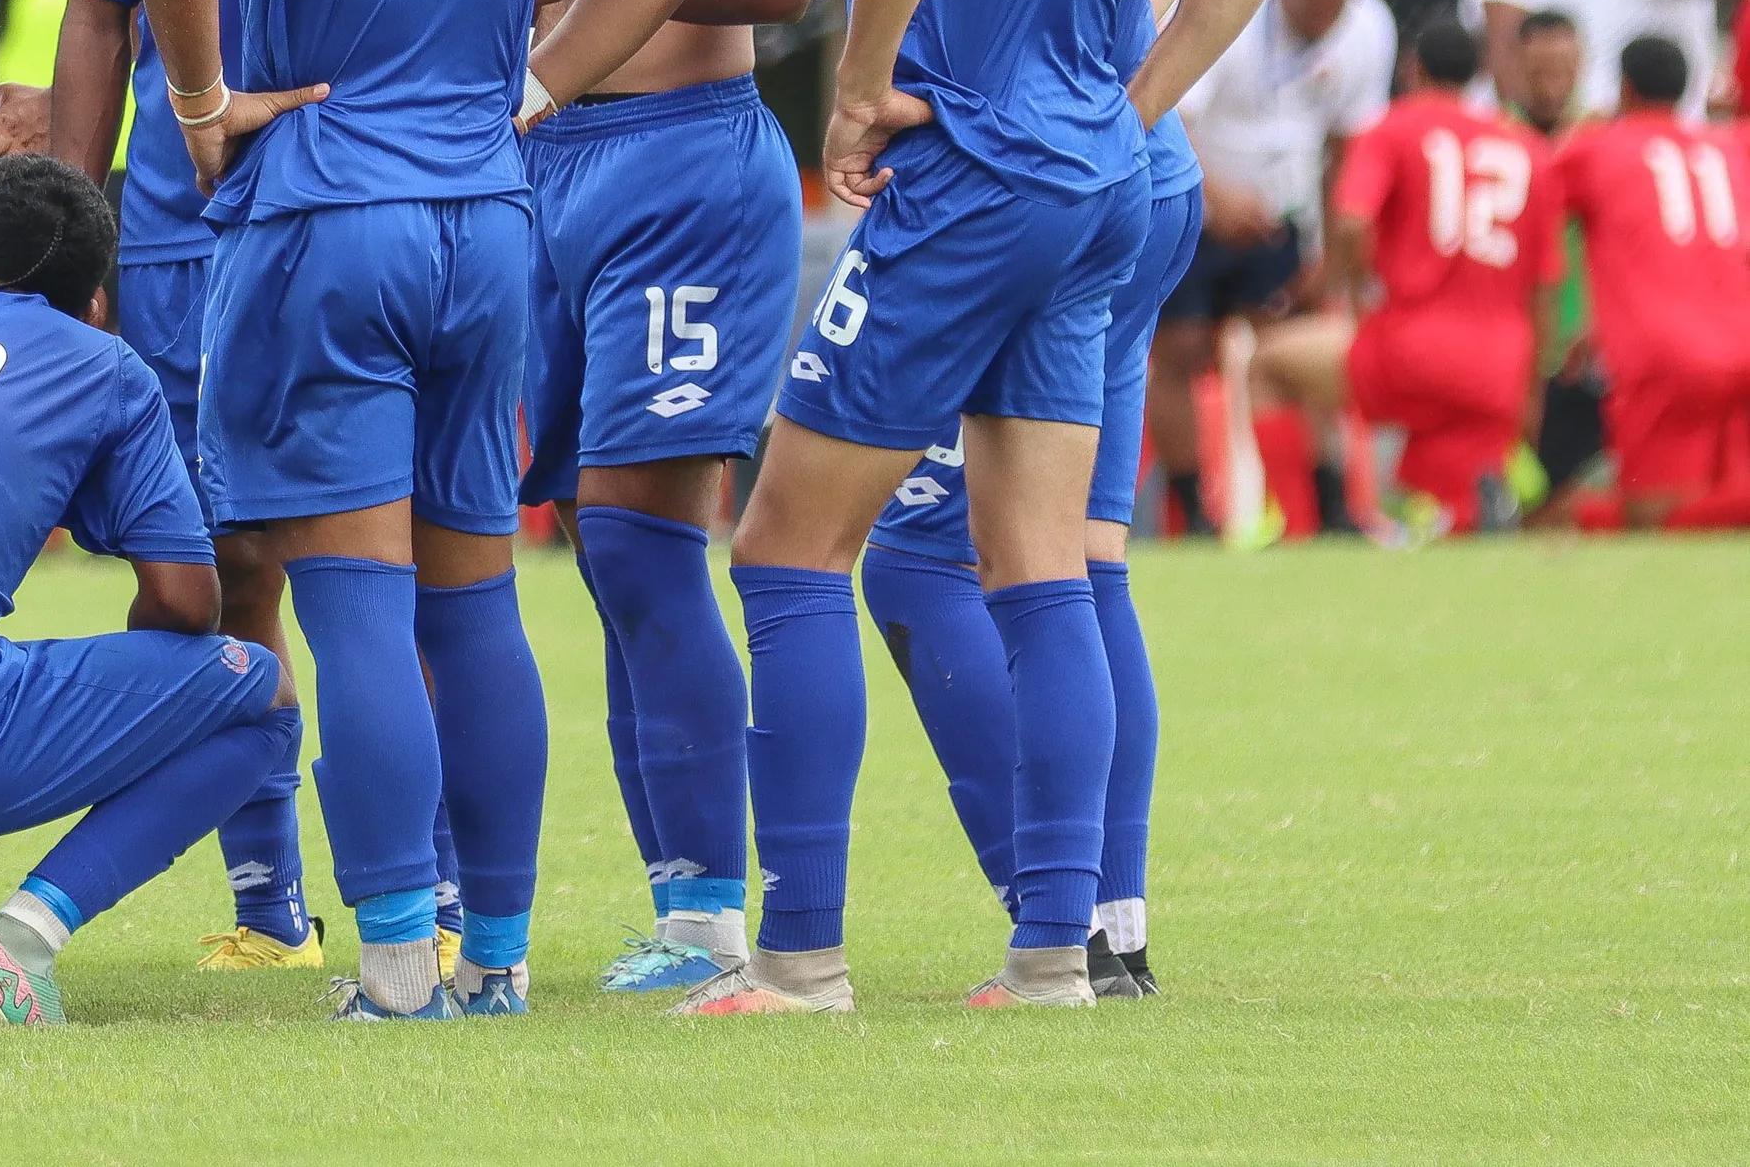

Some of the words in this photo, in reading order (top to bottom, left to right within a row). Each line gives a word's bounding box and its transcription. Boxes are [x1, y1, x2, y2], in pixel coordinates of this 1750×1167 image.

[1421, 128, 1532, 270] 12
[1643, 135, 1738, 250] 11
[645, 285, 719, 375] 15
